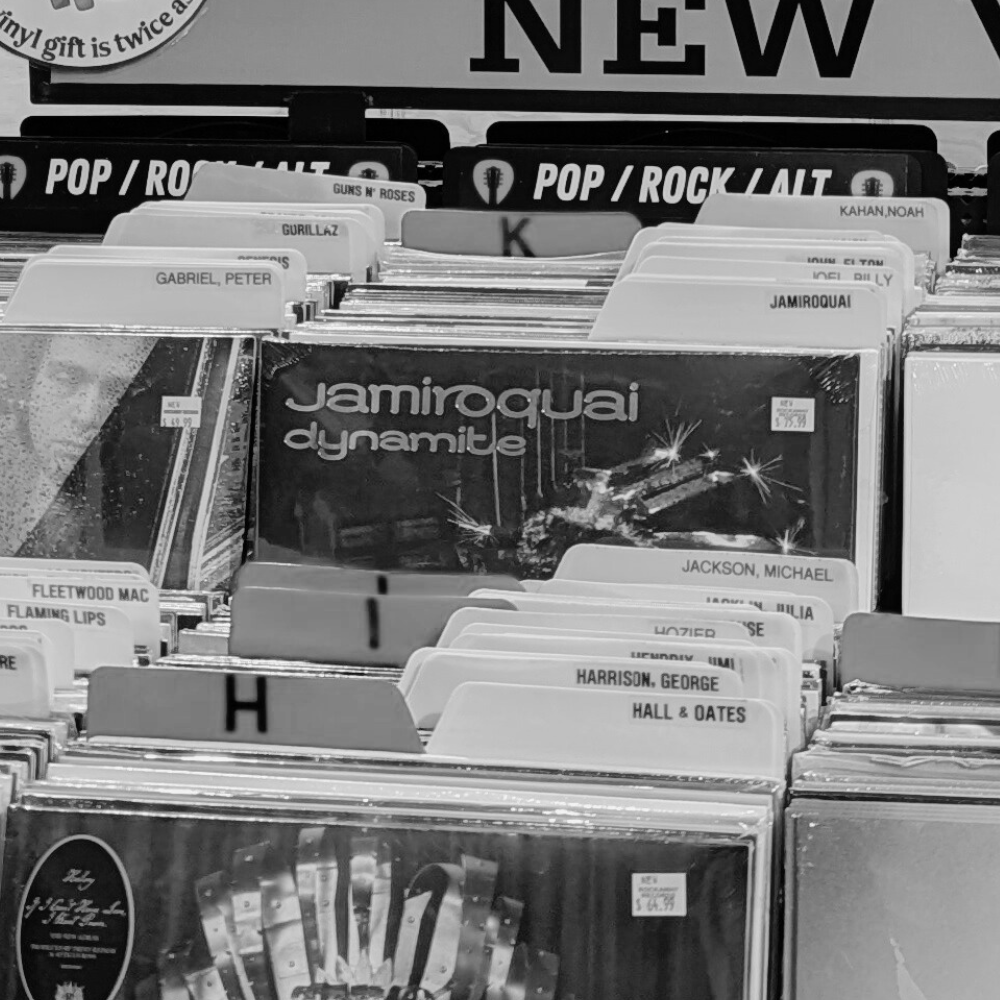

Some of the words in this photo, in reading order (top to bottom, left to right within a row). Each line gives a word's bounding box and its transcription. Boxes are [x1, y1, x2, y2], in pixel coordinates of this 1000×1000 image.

[41, 35, 86, 61] gift
[91, 36, 112, 59] is
[114, 9, 174, 54] twice
[45, 159, 113, 196] POP
[533, 162, 606, 202] POP
[638, 165, 736, 204] ROCK
[332, 182, 363, 198] GUNS
[379, 186, 416, 203] ROSES
[839, 206, 925, 219] KAHAN,NOAH
[282, 223, 339, 237] GORILLAZ
[501, 217, 537, 258] K
[155, 271, 221, 287] GABRIEL,
[225, 272, 272, 286] PETER
[769, 294, 852, 310] JAMIROQUAI
[284, 420, 527, 461] dynamite
[682, 559, 760, 580] JACKSON,
[764, 563, 834, 583] MICHAEL
[32, 583, 114, 601] FLEETWOOD
[118, 588, 150, 603] MAC
[7, 603, 70, 623] FLAMING
[73, 609, 106, 627] LIPS
[576, 668, 656, 688] HARRISON,
[660, 674, 720, 692] GEORGE
[224, 673, 268, 733] H
[632, 703, 673, 721] HALL
[678, 706, 690, 720] &
[693, 704, 747, 724] OATES
